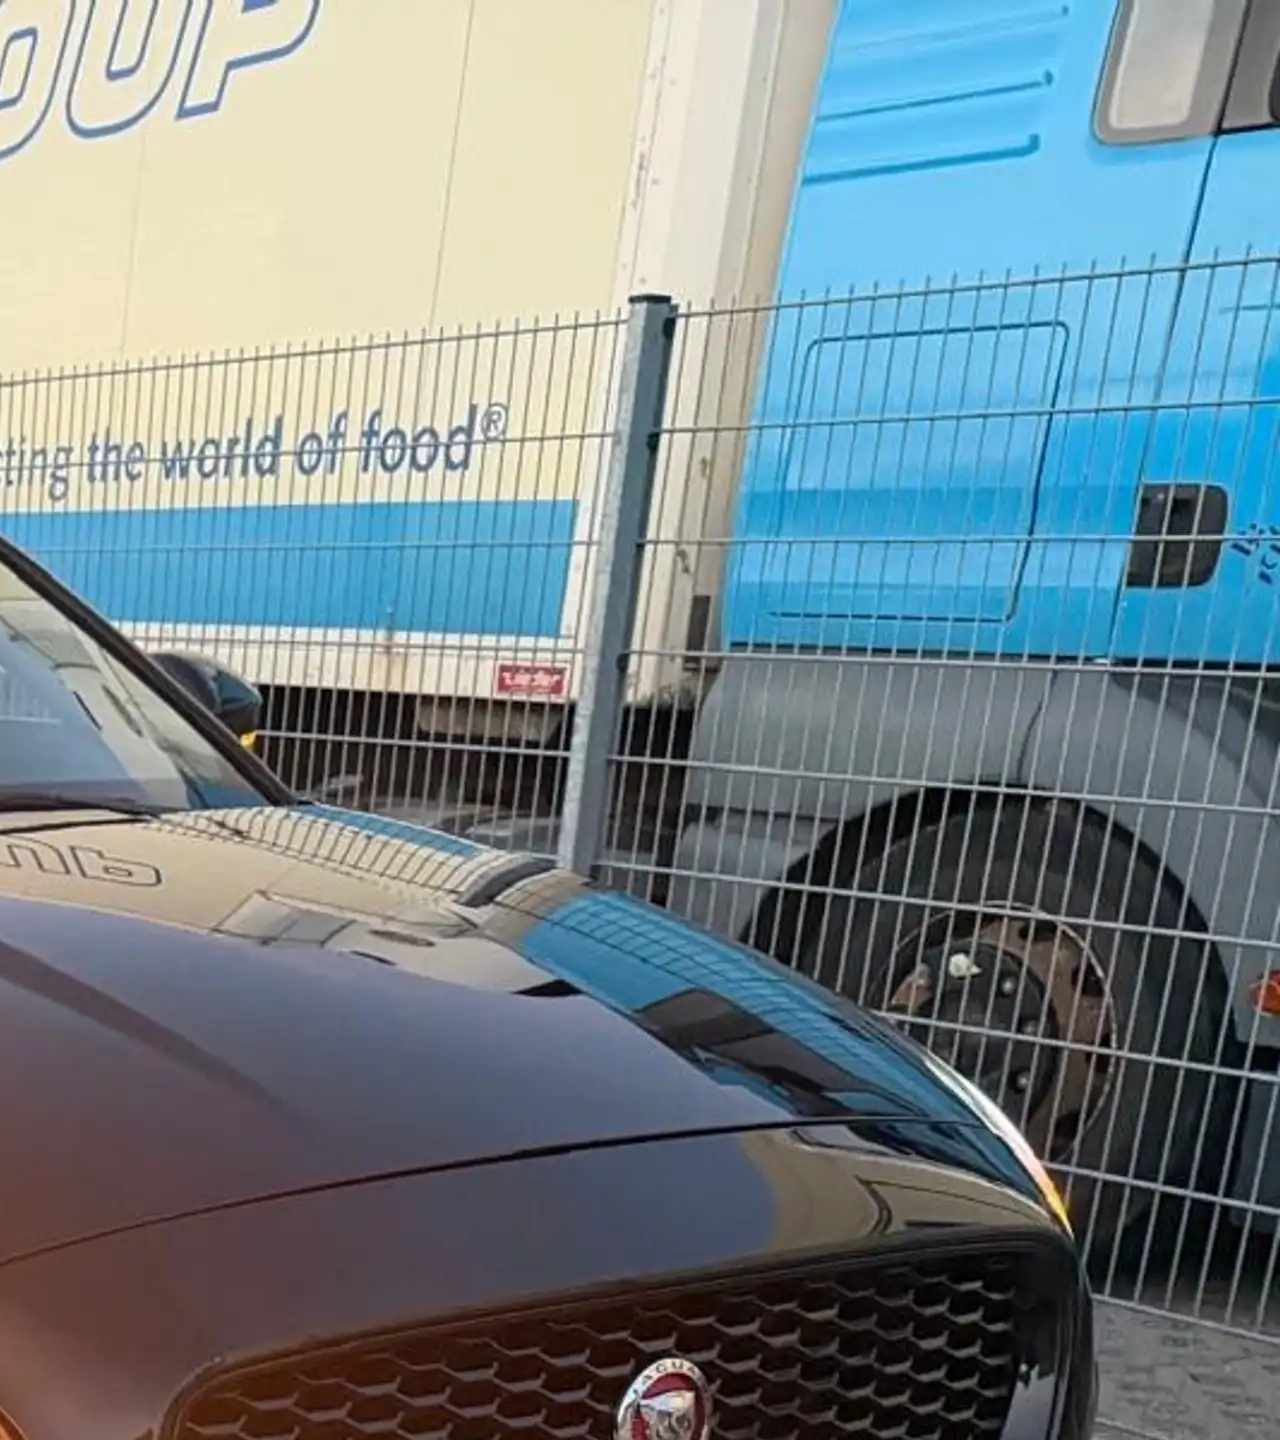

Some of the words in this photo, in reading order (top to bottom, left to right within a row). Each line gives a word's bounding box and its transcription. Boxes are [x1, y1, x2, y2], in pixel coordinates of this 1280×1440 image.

[87, 425, 144, 482] the
[161, 413, 283, 480] world
[297, 410, 349, 476] of
